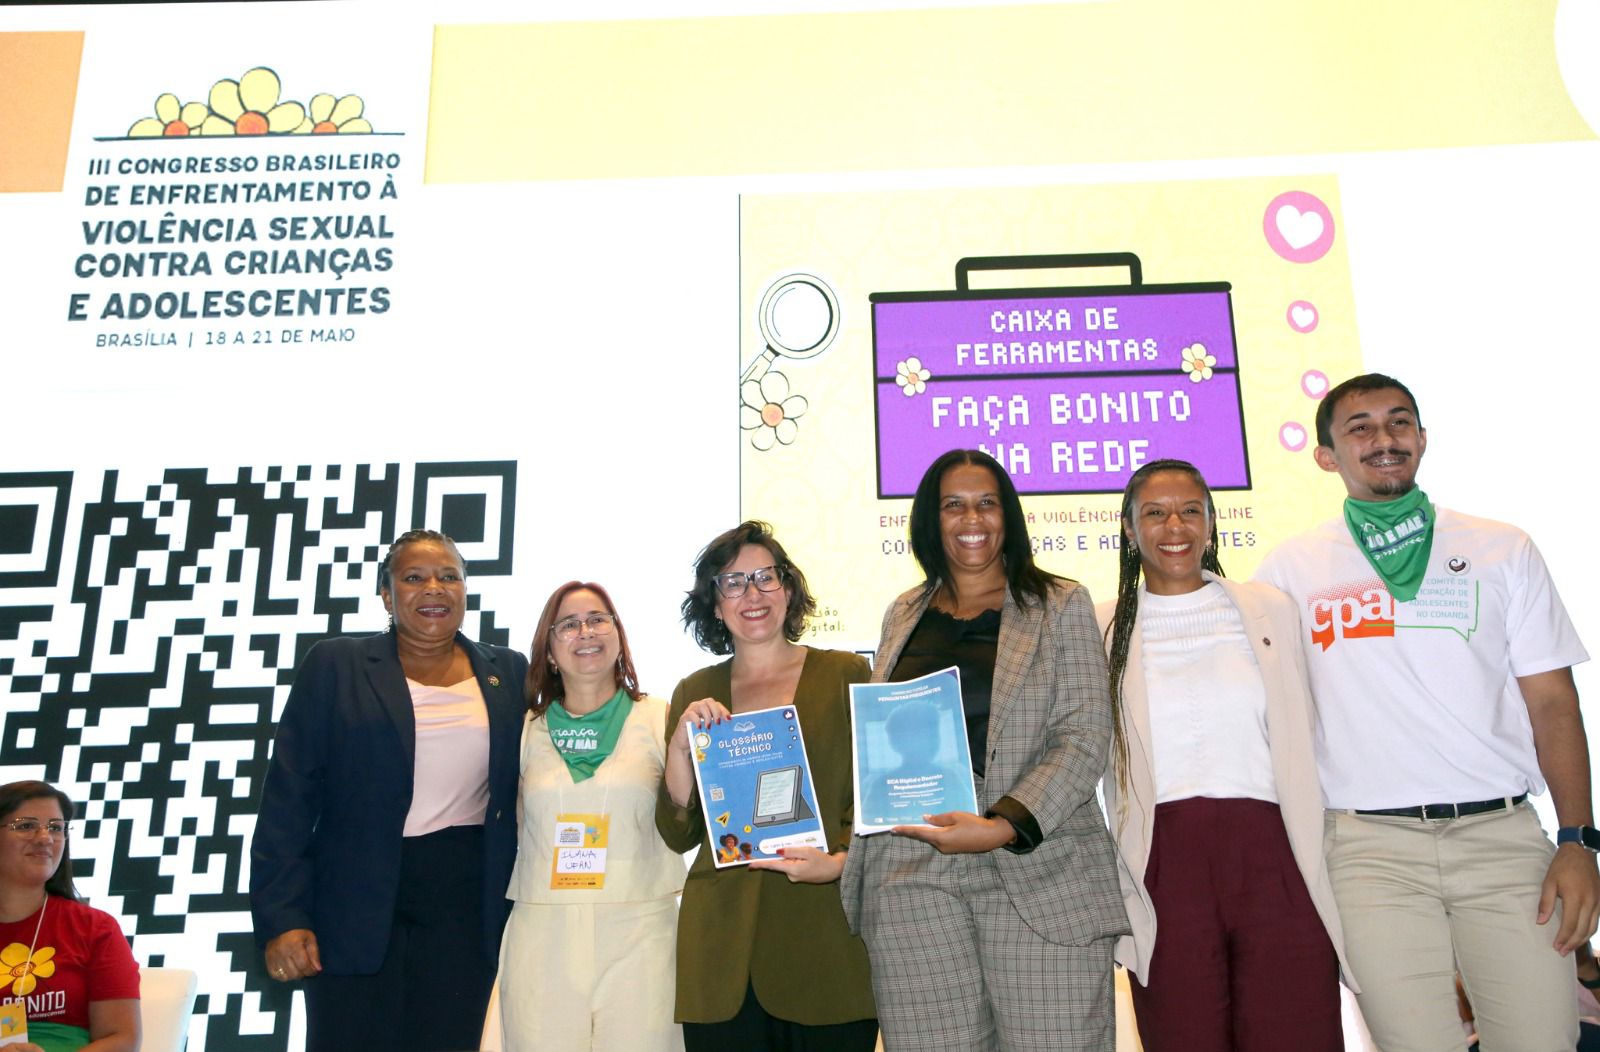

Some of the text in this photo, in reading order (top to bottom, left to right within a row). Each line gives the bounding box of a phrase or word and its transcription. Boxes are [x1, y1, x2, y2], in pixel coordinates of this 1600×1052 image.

[89, 153, 401, 175] III CONGRESSO BRASILEIRO
[85, 173, 399, 206] DE ENFRENTAMENTO À
[82, 212, 395, 245] VIOLÊNCIA SEXUAL
[74, 248, 394, 280] CONTRA CRIANÇAS
[67, 287, 391, 321] E ADOLESCENTES
[990, 307, 1119, 333] CAIXA DE
[96, 329, 178, 348] BRASÍLIA
[205, 332, 226, 345] 18
[233, 331, 245, 344] A
[252, 330, 272, 344] 21
[281, 330, 303, 344] DE
[310, 328, 356, 343] MAIO
[956, 338, 1159, 366] FERRAMENTAS
[931, 389, 1192, 436] FAÇA BONITO
[1051, 439, 1150, 474] REDE
[1043, 507, 1122, 523] VIOLÊNCIA
[1217, 507, 1254, 520] LINE
[1077, 535, 1089, 551] E
[1420, 588, 1469, 597] ICIPAÇÃO DE
[1457, 578, 1469, 586] DE
[1311, 587, 1395, 643] cpa
[1430, 611, 1470, 620] CONANDA
[811, 620, 846, 637] gital:
[718, 731, 774, 749] GLOSSÁRIO
[729, 743, 771, 757] TÉCNICO
